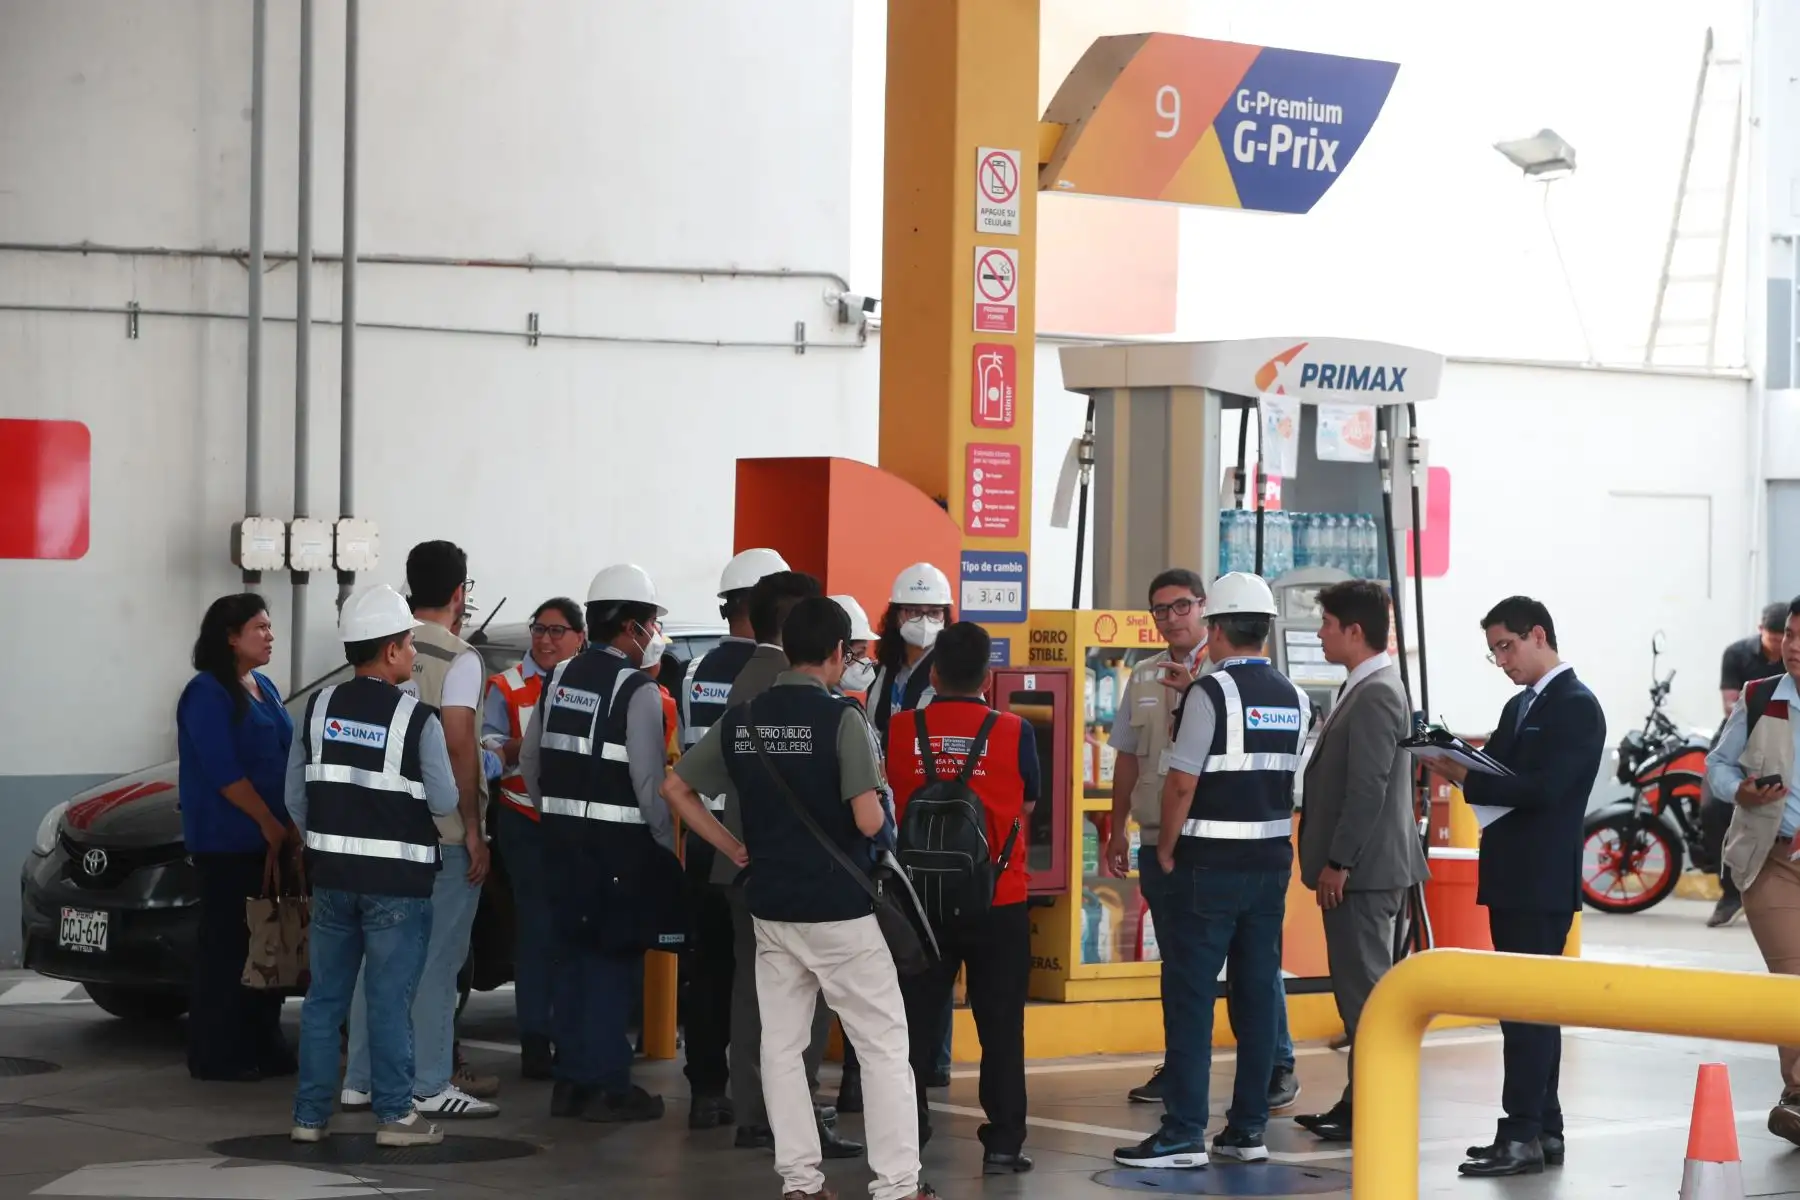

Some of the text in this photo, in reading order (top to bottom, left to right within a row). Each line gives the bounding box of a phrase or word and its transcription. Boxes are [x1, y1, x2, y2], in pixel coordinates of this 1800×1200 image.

[1155, 84, 1181, 139] 9
[1236, 88, 1343, 125] G-Premium
[1233, 119, 1341, 173] G-Prix
[980, 207, 1016, 218] APAGUE SU
[984, 217, 1012, 228] CELULAR
[1300, 362, 1408, 392] PRIMAX
[1004, 385, 1013, 423] Extintor
[961, 561, 1023, 574] Tipo de cambio
[1126, 615, 1148, 626] Shell
[703, 687, 729, 699] SUN
[563, 693, 596, 708] SUNAT
[1262, 713, 1298, 724] SUNAT
[342, 726, 385, 742] SUNAT
[735, 728, 780, 739] MINTERIO
[789, 740, 813, 752] PERÚ
[61, 918, 107, 945] CCJ-617
